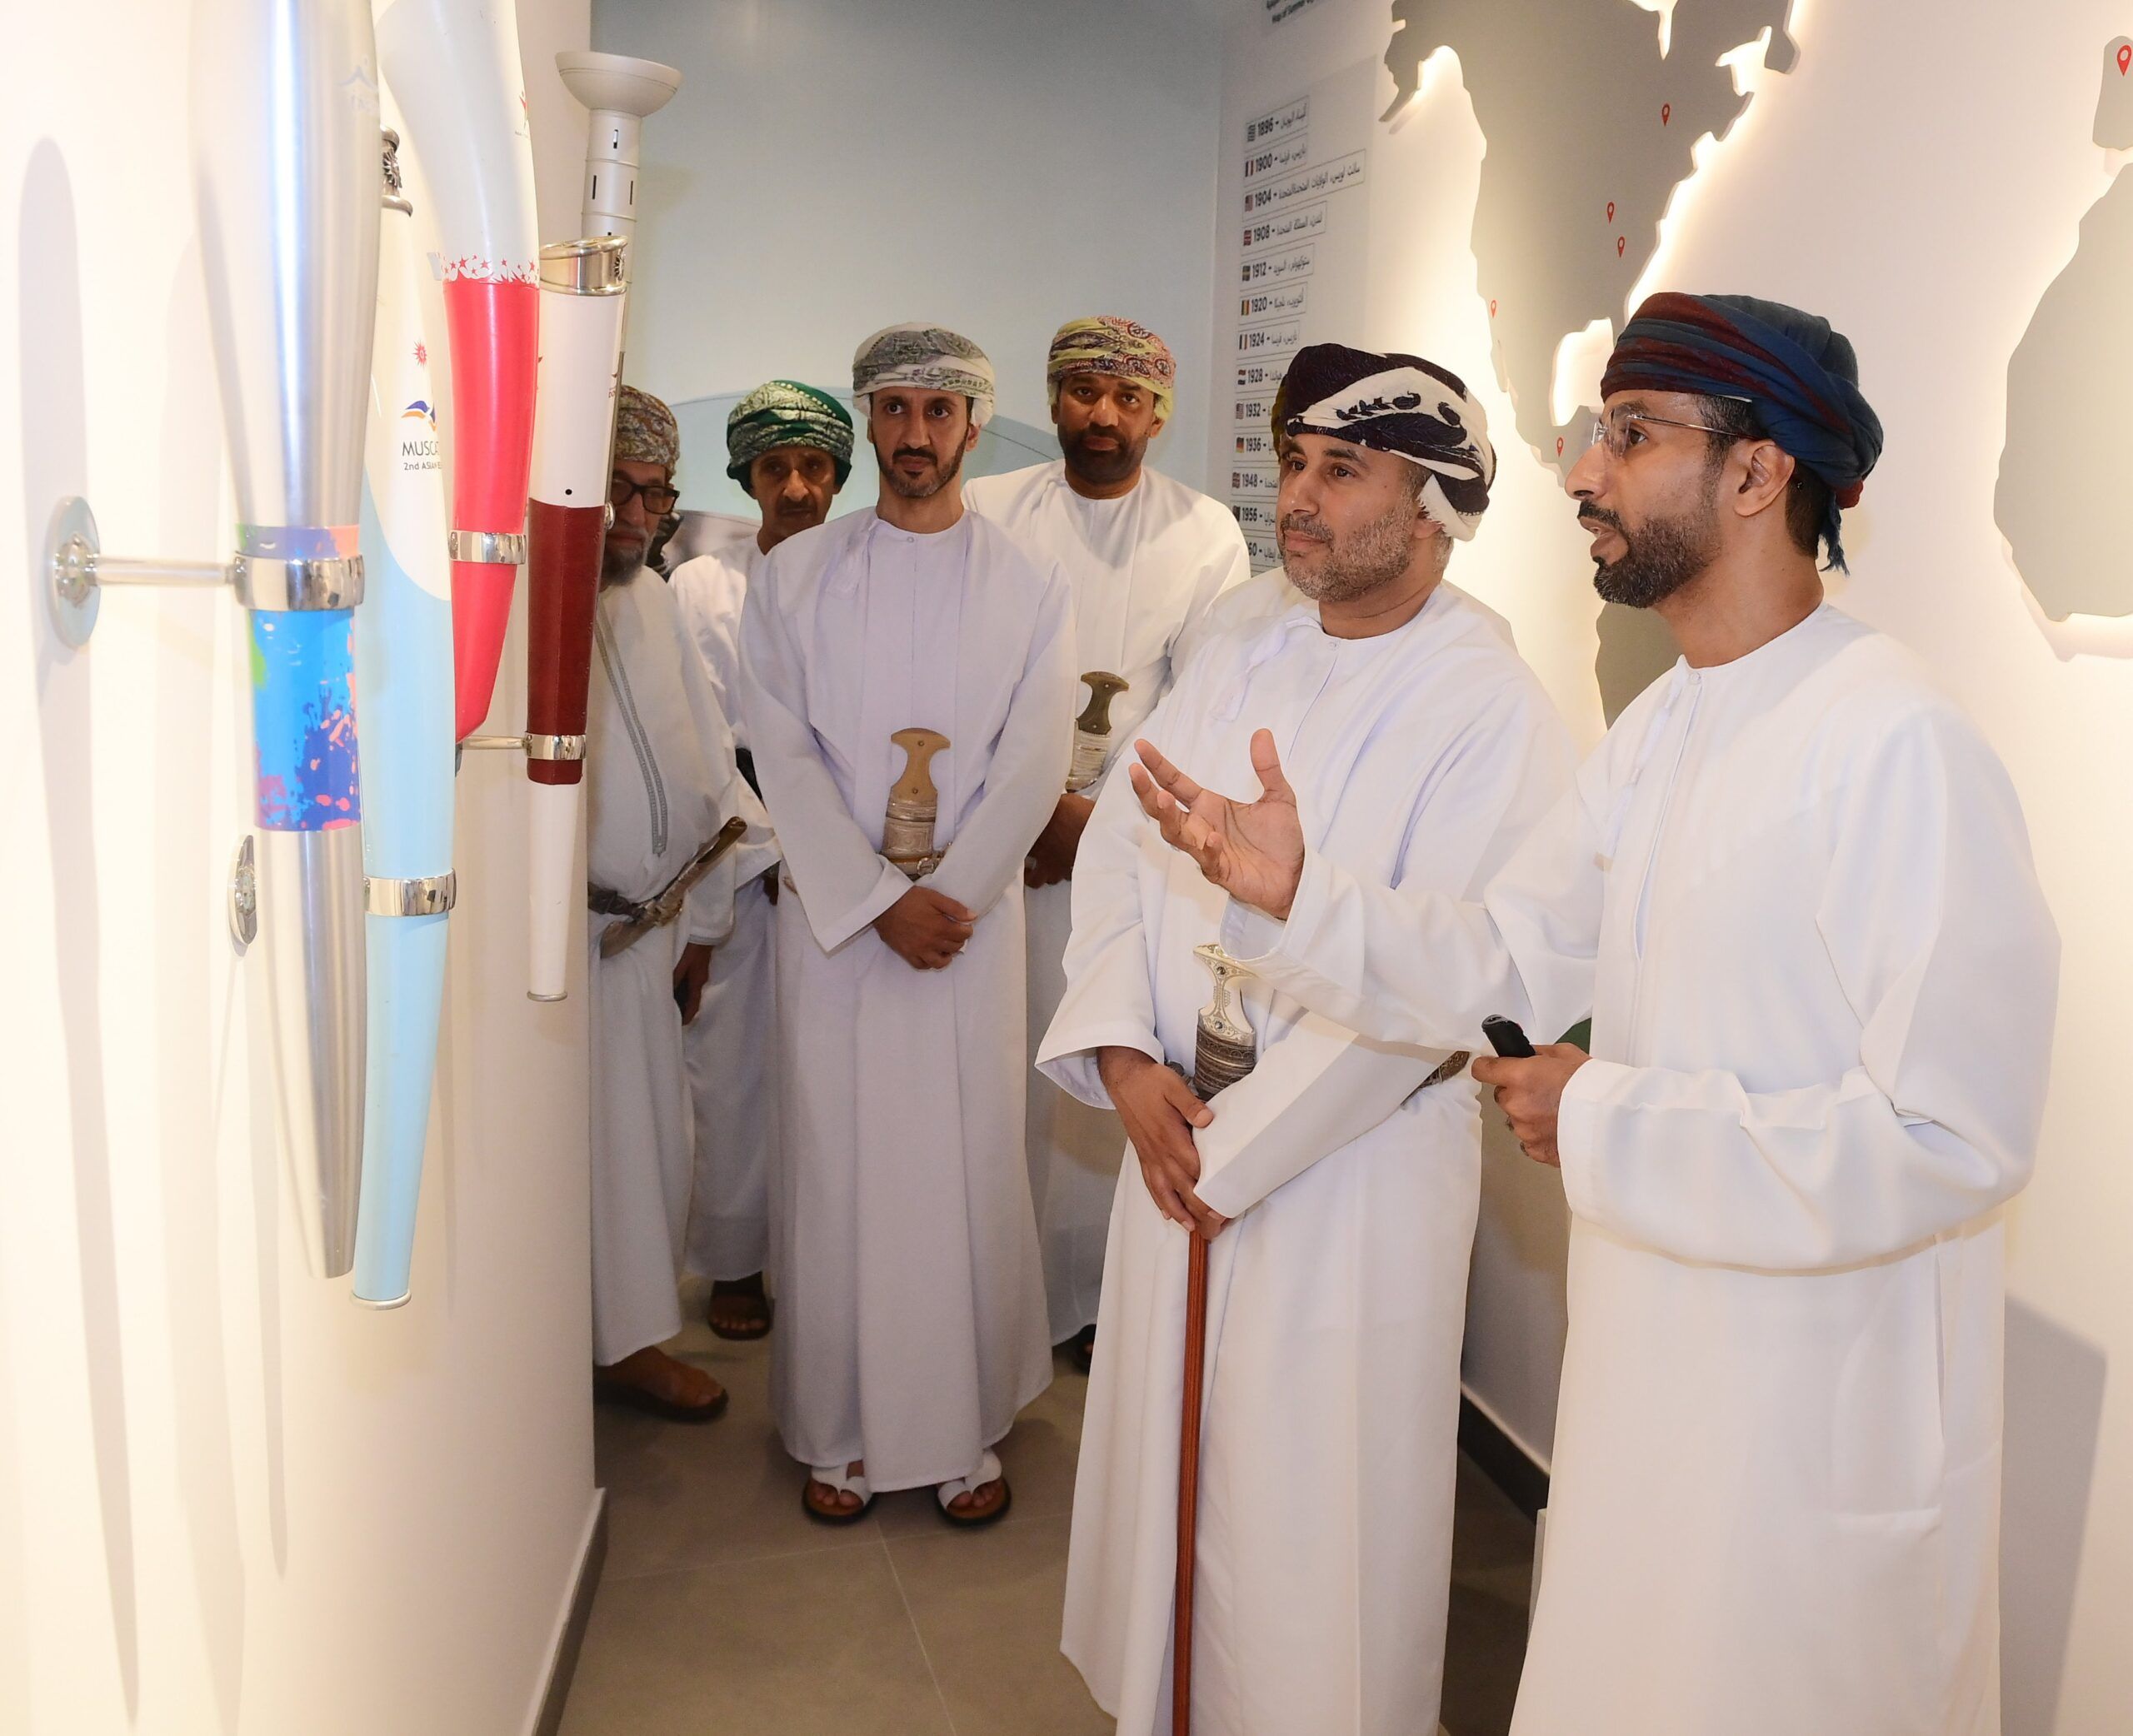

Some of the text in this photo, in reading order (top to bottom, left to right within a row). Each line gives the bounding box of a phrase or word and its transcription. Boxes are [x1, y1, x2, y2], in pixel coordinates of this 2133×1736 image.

[1257, 117, 1273, 137] 1896
[1256, 153, 1272, 172] 1900
[1255, 188, 1271, 207] 1904
[1254, 225, 1270, 242] 1908
[1252, 262, 1266, 278] 1912
[1251, 297, 1267, 312] 1920
[1249, 332, 1265, 347] 1924
[1248, 368, 1263, 384] 1928
[1246, 403, 1261, 417] 1932
[1246, 437, 1261, 452] 1936
[403, 461, 419, 470] 2nd
[1242, 473, 1258, 488] 1948
[1242, 507, 1258, 522] 1956
[1248, 541, 1257, 556] 60
